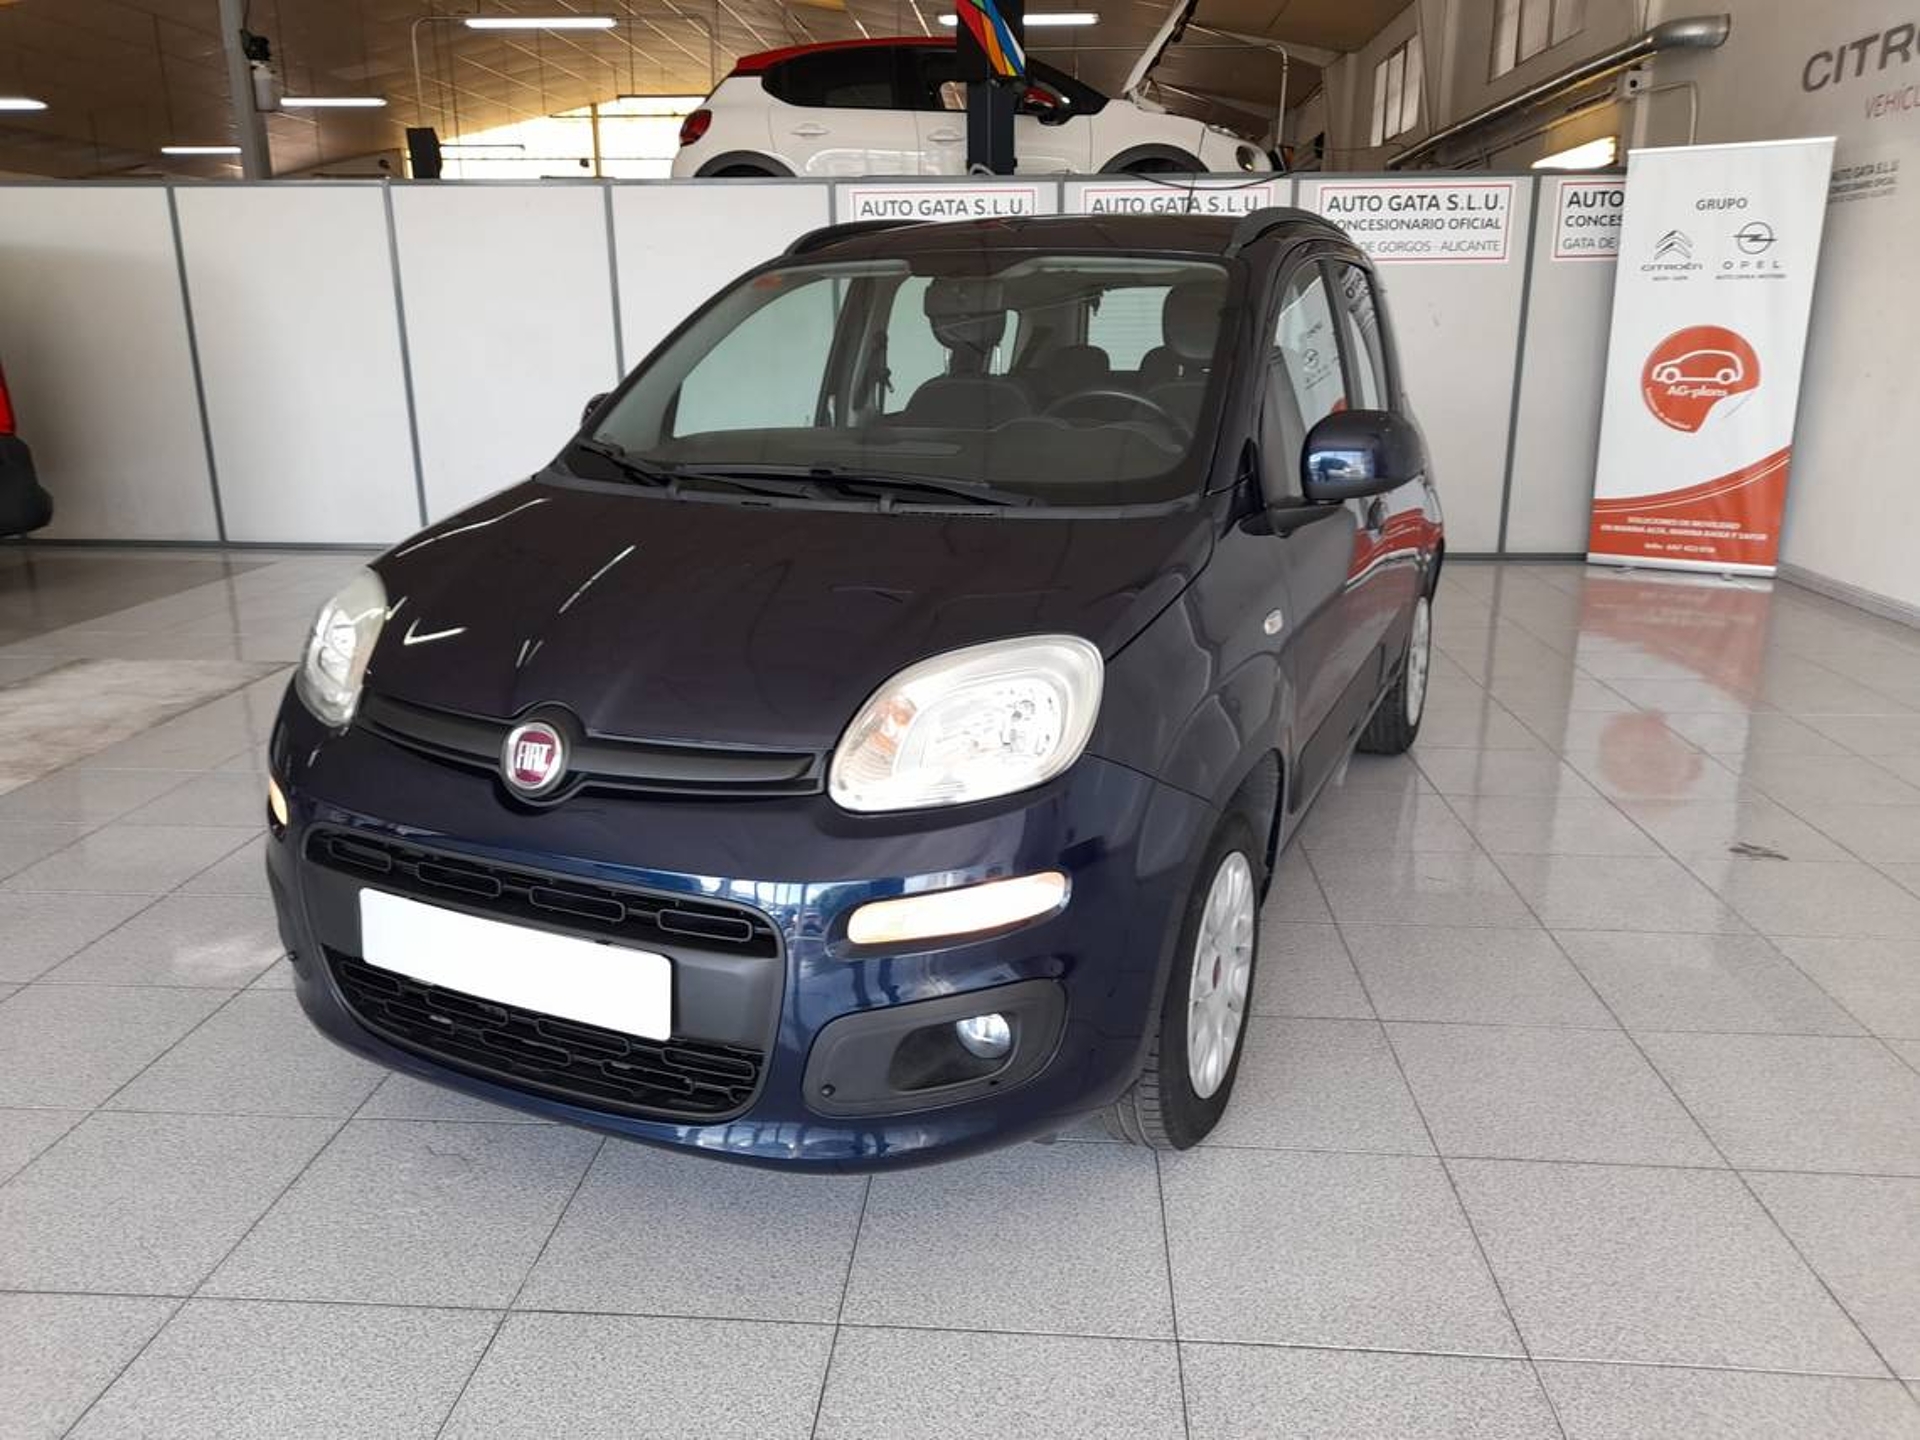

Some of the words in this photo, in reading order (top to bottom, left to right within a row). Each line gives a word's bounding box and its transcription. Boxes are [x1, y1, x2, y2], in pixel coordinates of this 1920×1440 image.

[1803, 23, 1920, 92] CITR
[861, 200, 913, 216] AUTO
[918, 199, 969, 215] GATA
[1092, 197, 1144, 213] AUTO
[1150, 196, 1201, 213] GATA
[1327, 195, 1383, 212] AUTO
[1388, 194, 1440, 211] GATA
[1446, 193, 1504, 210] S.L.U.
[1567, 190, 1624, 208] AUTO
[1695, 197, 1748, 211] GRUPO
[1334, 217, 1444, 230] ONCESIONARIO
[1448, 217, 1502, 230] OFICIAL
[1377, 240, 1431, 253] GORGOS
[1441, 239, 1499, 251] ALICANTE
[1563, 238, 1595, 250] GATA
[1598, 237, 1615, 249] DE
[1722, 260, 1781, 271] OPEL
[516, 740, 552, 773] FIAT
